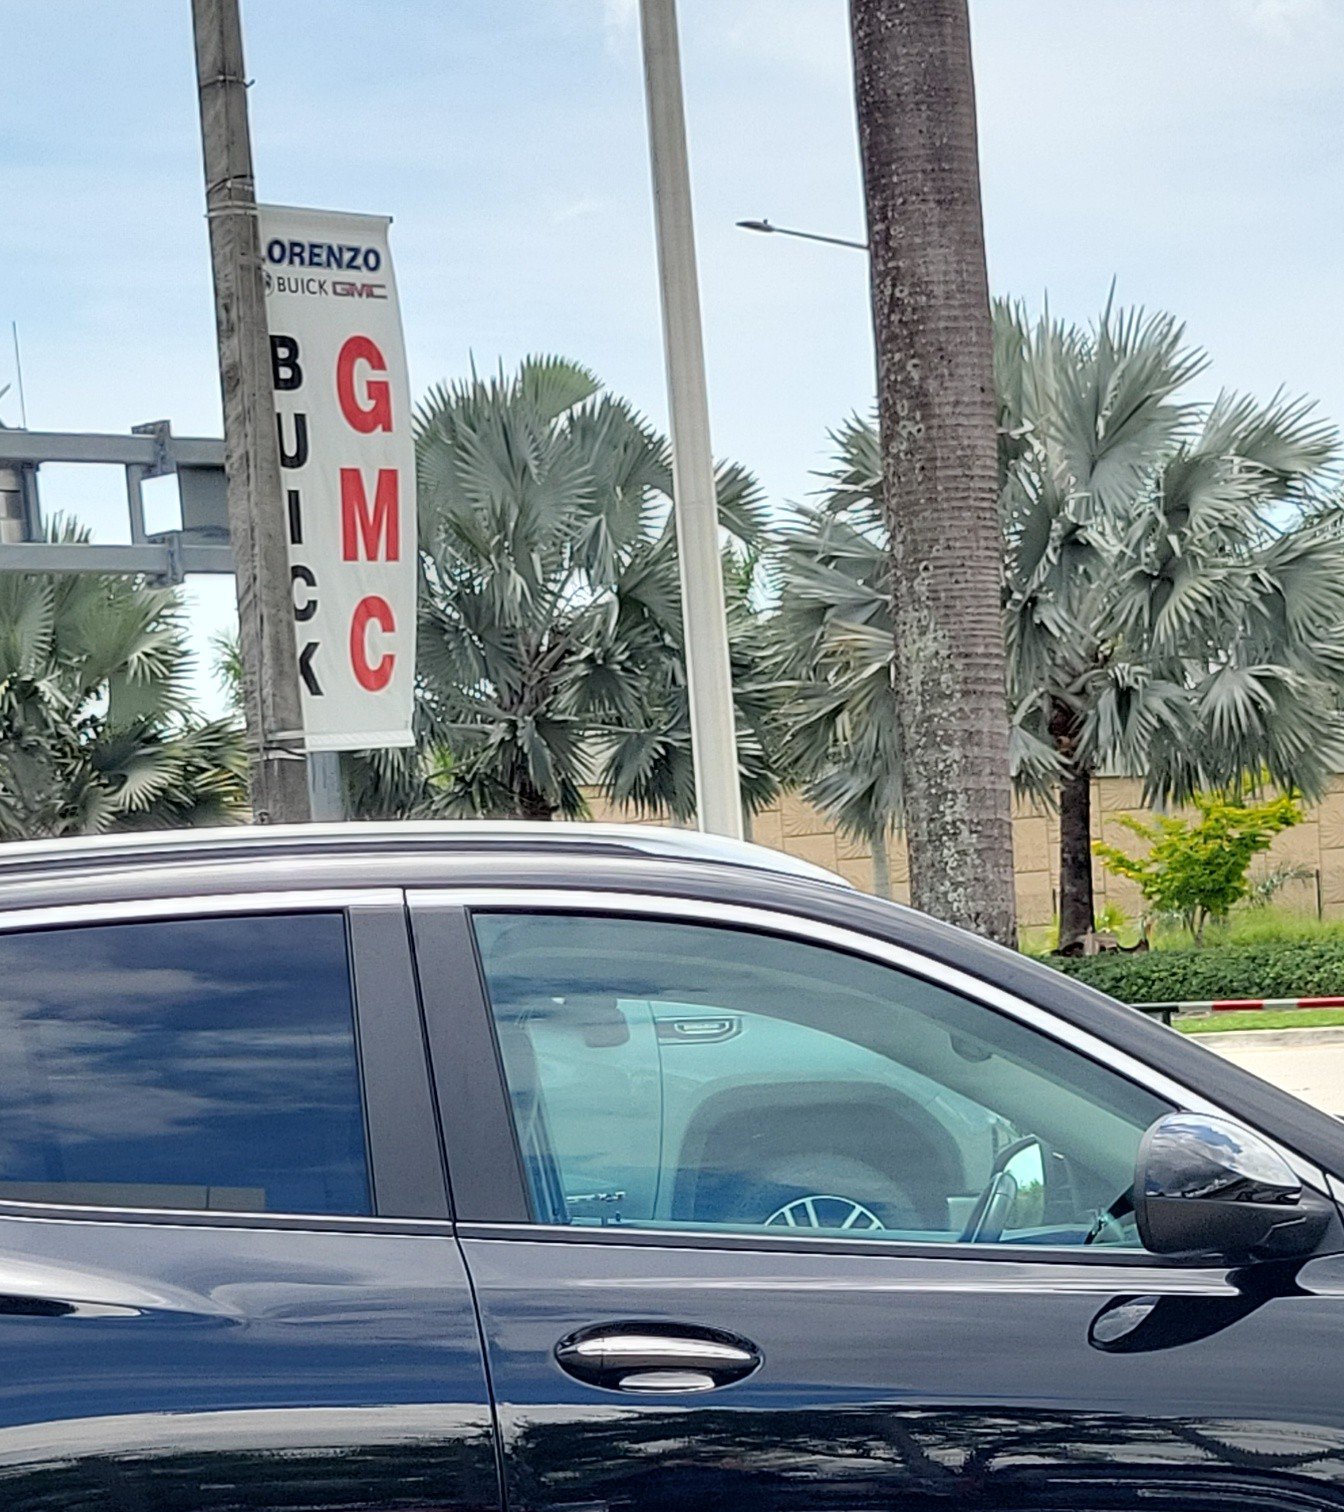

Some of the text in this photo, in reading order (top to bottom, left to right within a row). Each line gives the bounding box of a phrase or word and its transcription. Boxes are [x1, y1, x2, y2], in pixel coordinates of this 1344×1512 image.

[260, 239, 381, 272] ORENZO
[276, 276, 388, 299] BUICK GMC
[336, 335, 400, 692] GMC
